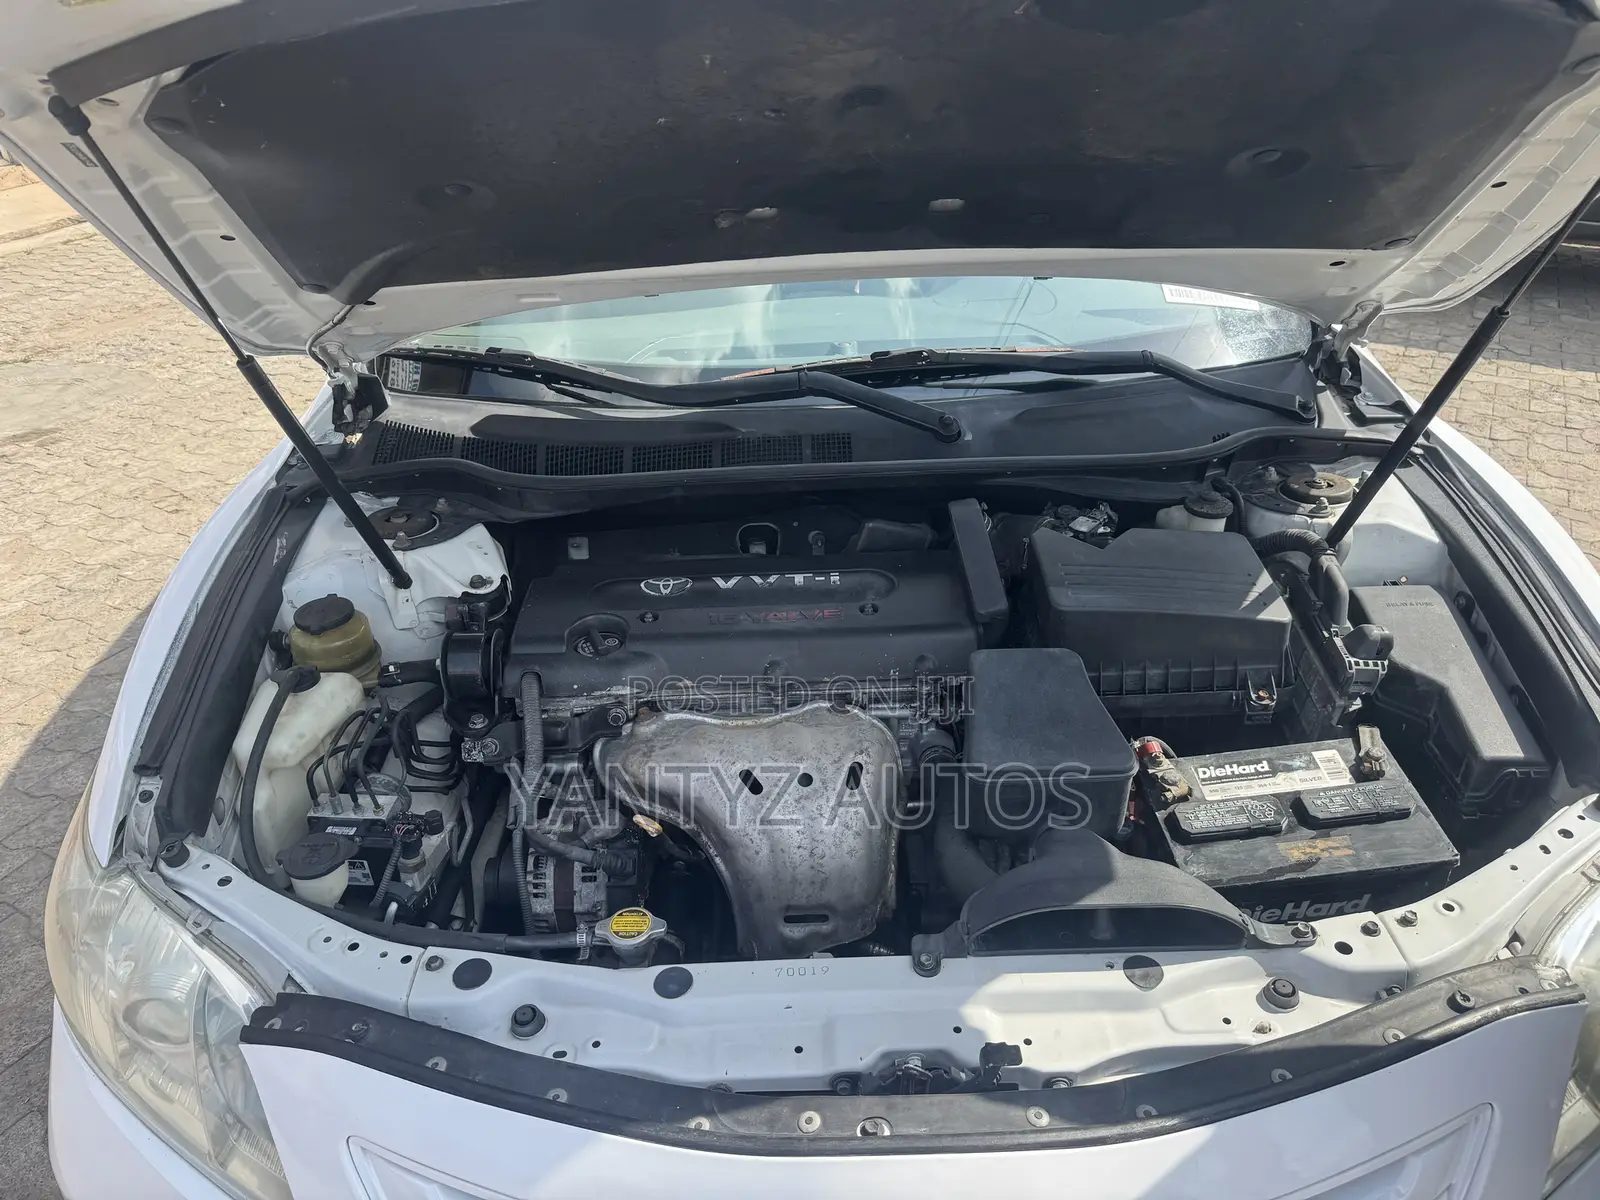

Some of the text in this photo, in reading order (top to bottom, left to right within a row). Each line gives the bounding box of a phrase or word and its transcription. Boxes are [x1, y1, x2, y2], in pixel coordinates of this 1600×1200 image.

[711, 572, 841, 589] VVT-i
[1197, 760, 1270, 779] DieHard
[1298, 775, 1323, 784] SILVER
[774, 965, 830, 978] 70019
